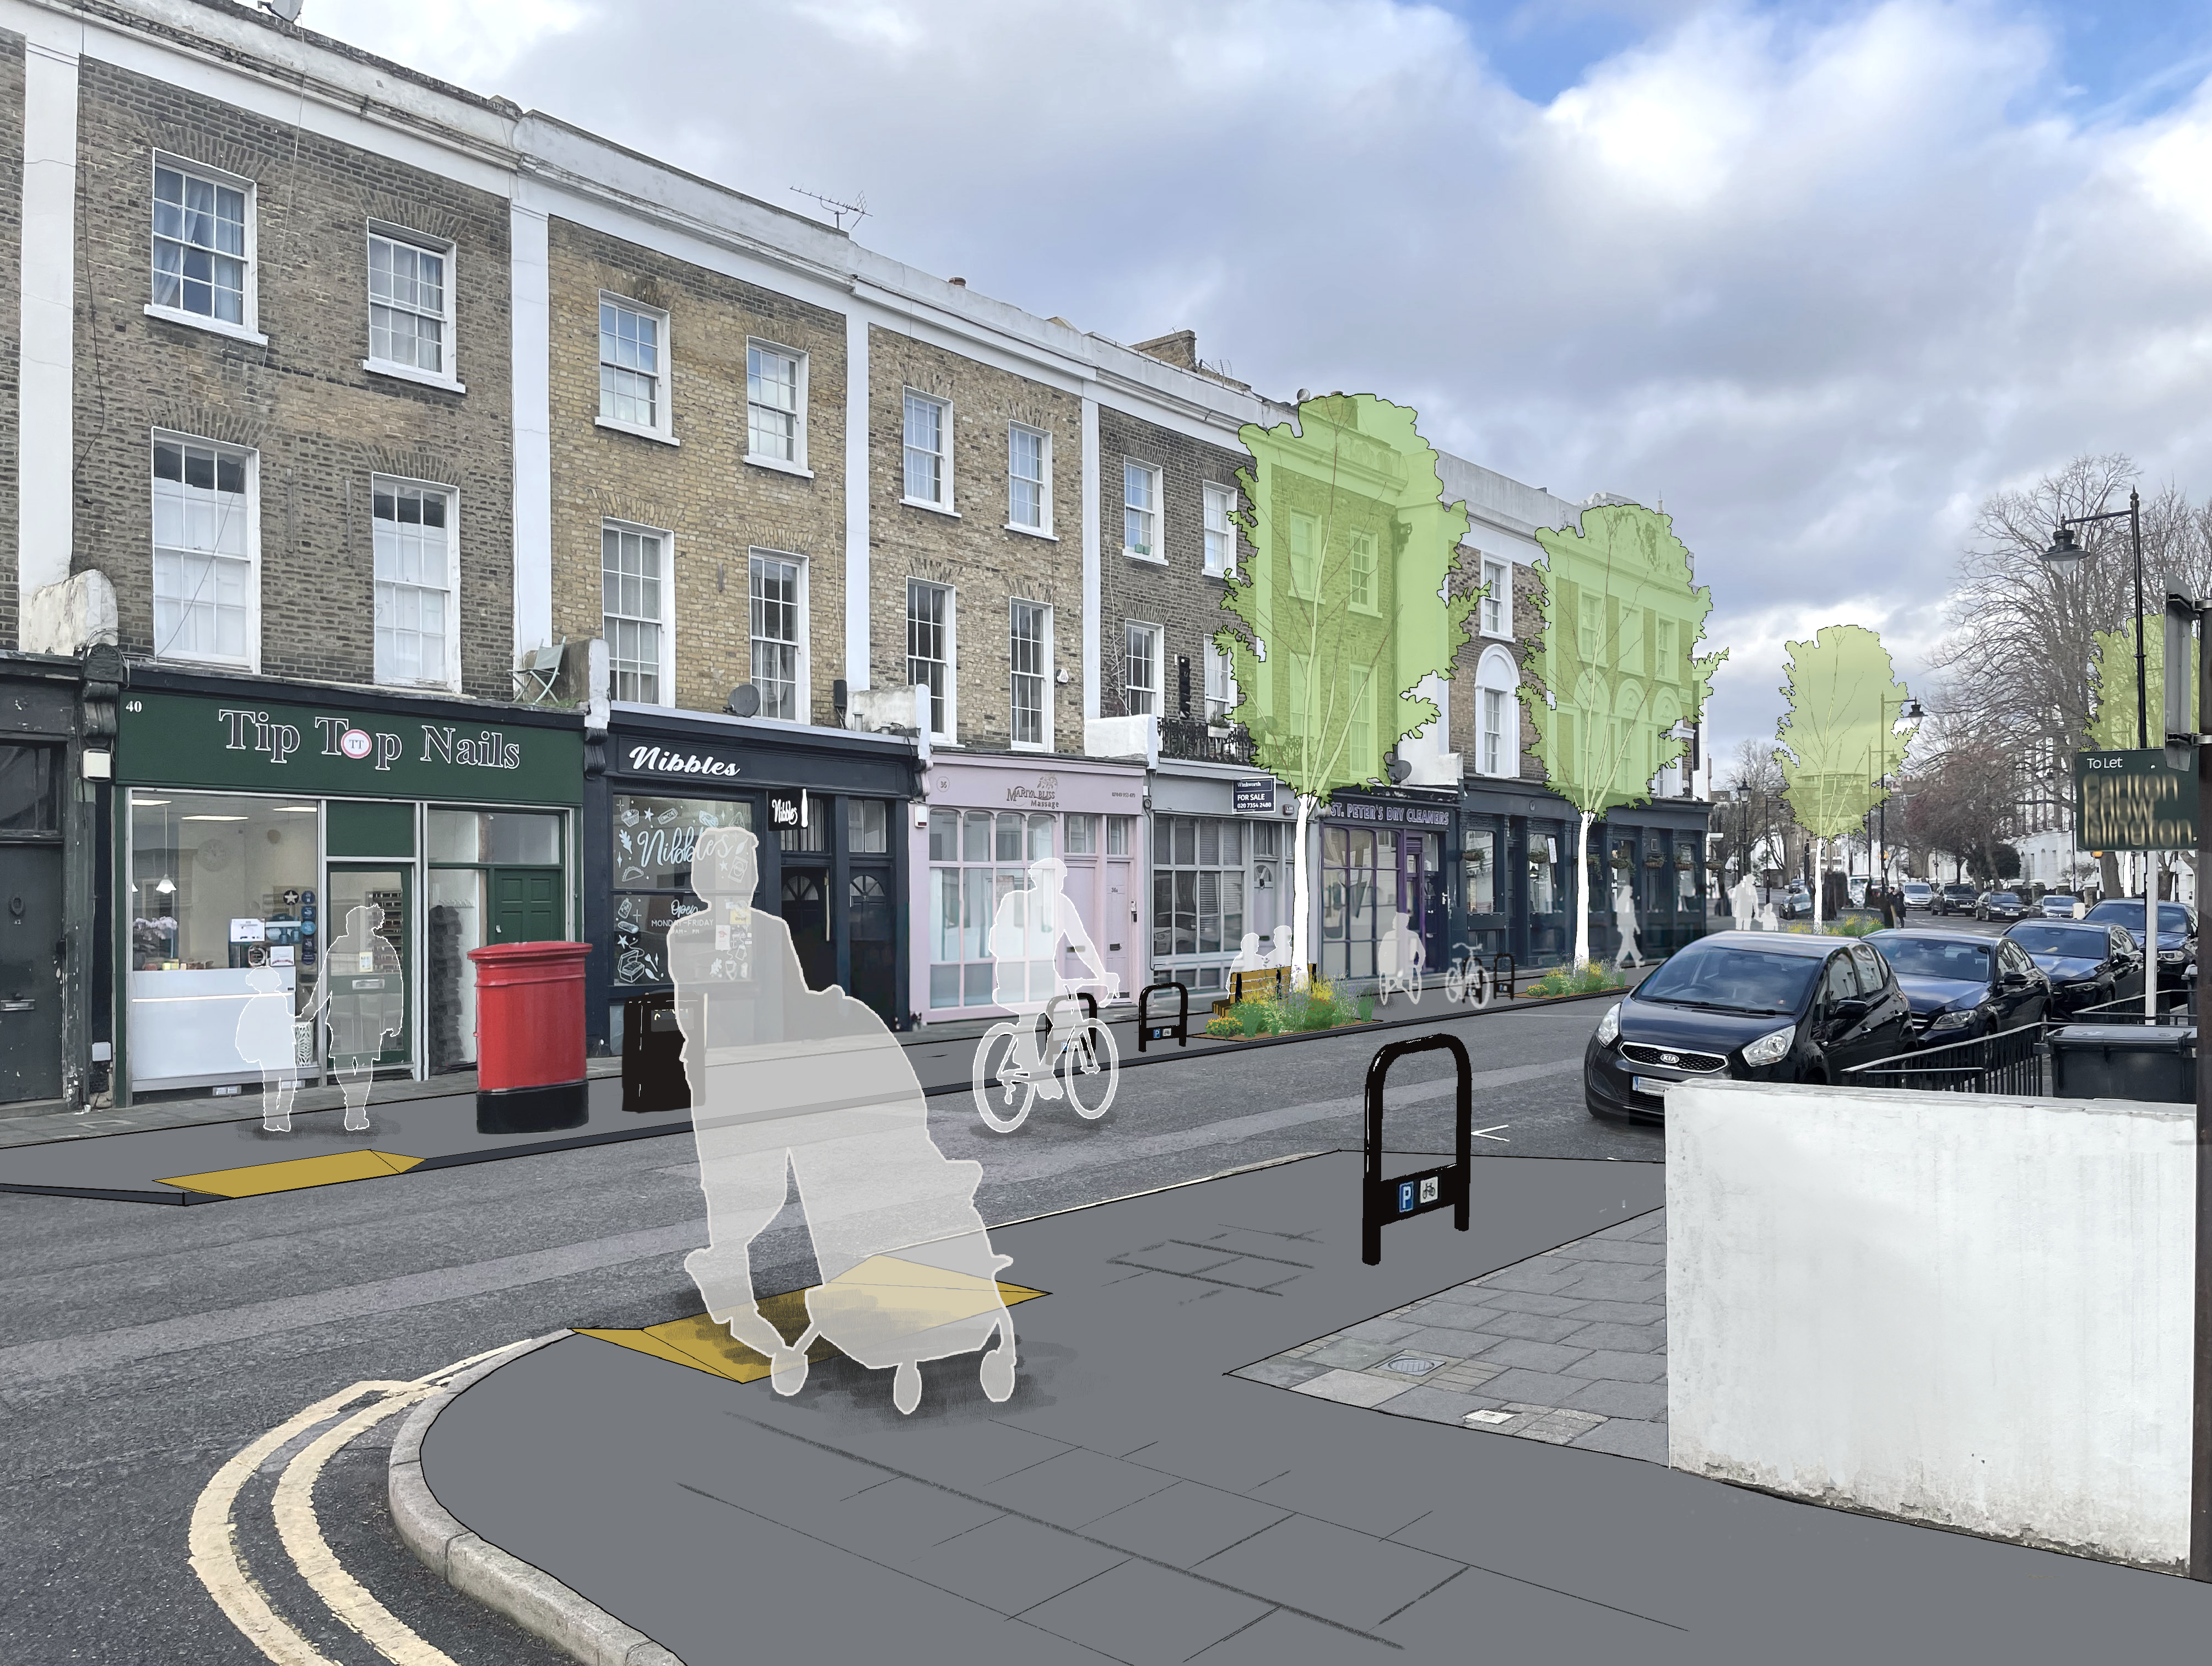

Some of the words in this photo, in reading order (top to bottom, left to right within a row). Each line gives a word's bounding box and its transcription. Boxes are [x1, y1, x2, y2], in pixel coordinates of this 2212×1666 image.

[126, 701, 142, 712] 40
[218, 708, 301, 764] Tip
[314, 716, 402, 771] Top
[420, 725, 520, 769] Nails
[629, 746, 740, 776] Nibbles
[2087, 758, 2102, 769] To
[2103, 756, 2123, 769] Let
[1007, 787, 1036, 801] MARIYA
[1038, 790, 1055, 799] BLISS
[1031, 799, 1059, 809] Massage
[772, 799, 798, 825] Nibbles
[1331, 802, 1344, 816] ST.
[1347, 803, 1384, 820] PETER'S
[1386, 807, 1404, 821] DRY
[1407, 808, 1450, 825] CLEANERS
[637, 826, 734, 868] Nibbles
[1663, 1054, 1676, 1063] KIA
[1402, 1186, 1411, 1209] P
